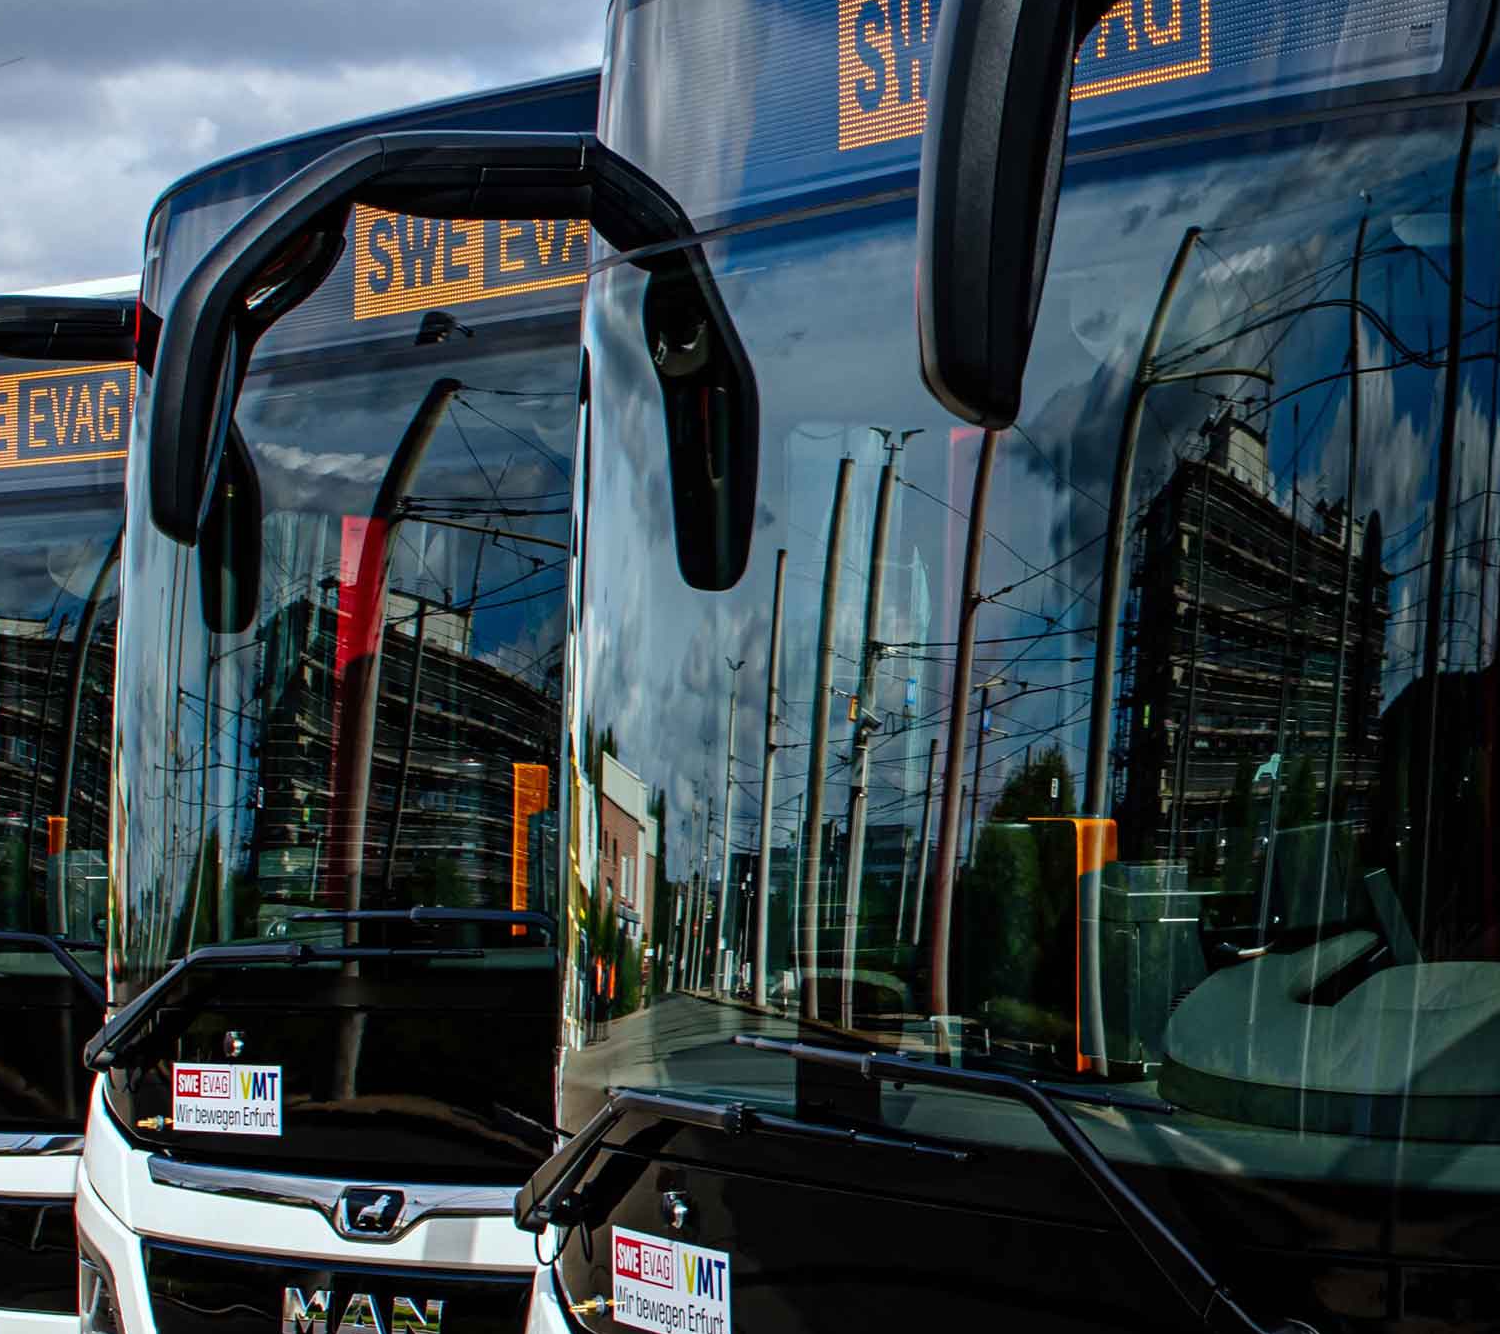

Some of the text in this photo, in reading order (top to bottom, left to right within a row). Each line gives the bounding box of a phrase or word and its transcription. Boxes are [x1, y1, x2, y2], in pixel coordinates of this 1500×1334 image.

[367, 217, 469, 295] SWE
[28, 381, 121, 449] EVAG
[178, 1070, 278, 1101] SWE EVAG VMT
[176, 1103, 279, 1130] Wir bewegen Erfurt.
[617, 1242, 726, 1302] SWE EVAG VMT
[615, 1285, 634, 1316] Wir
[636, 1290, 686, 1333] bewegen
